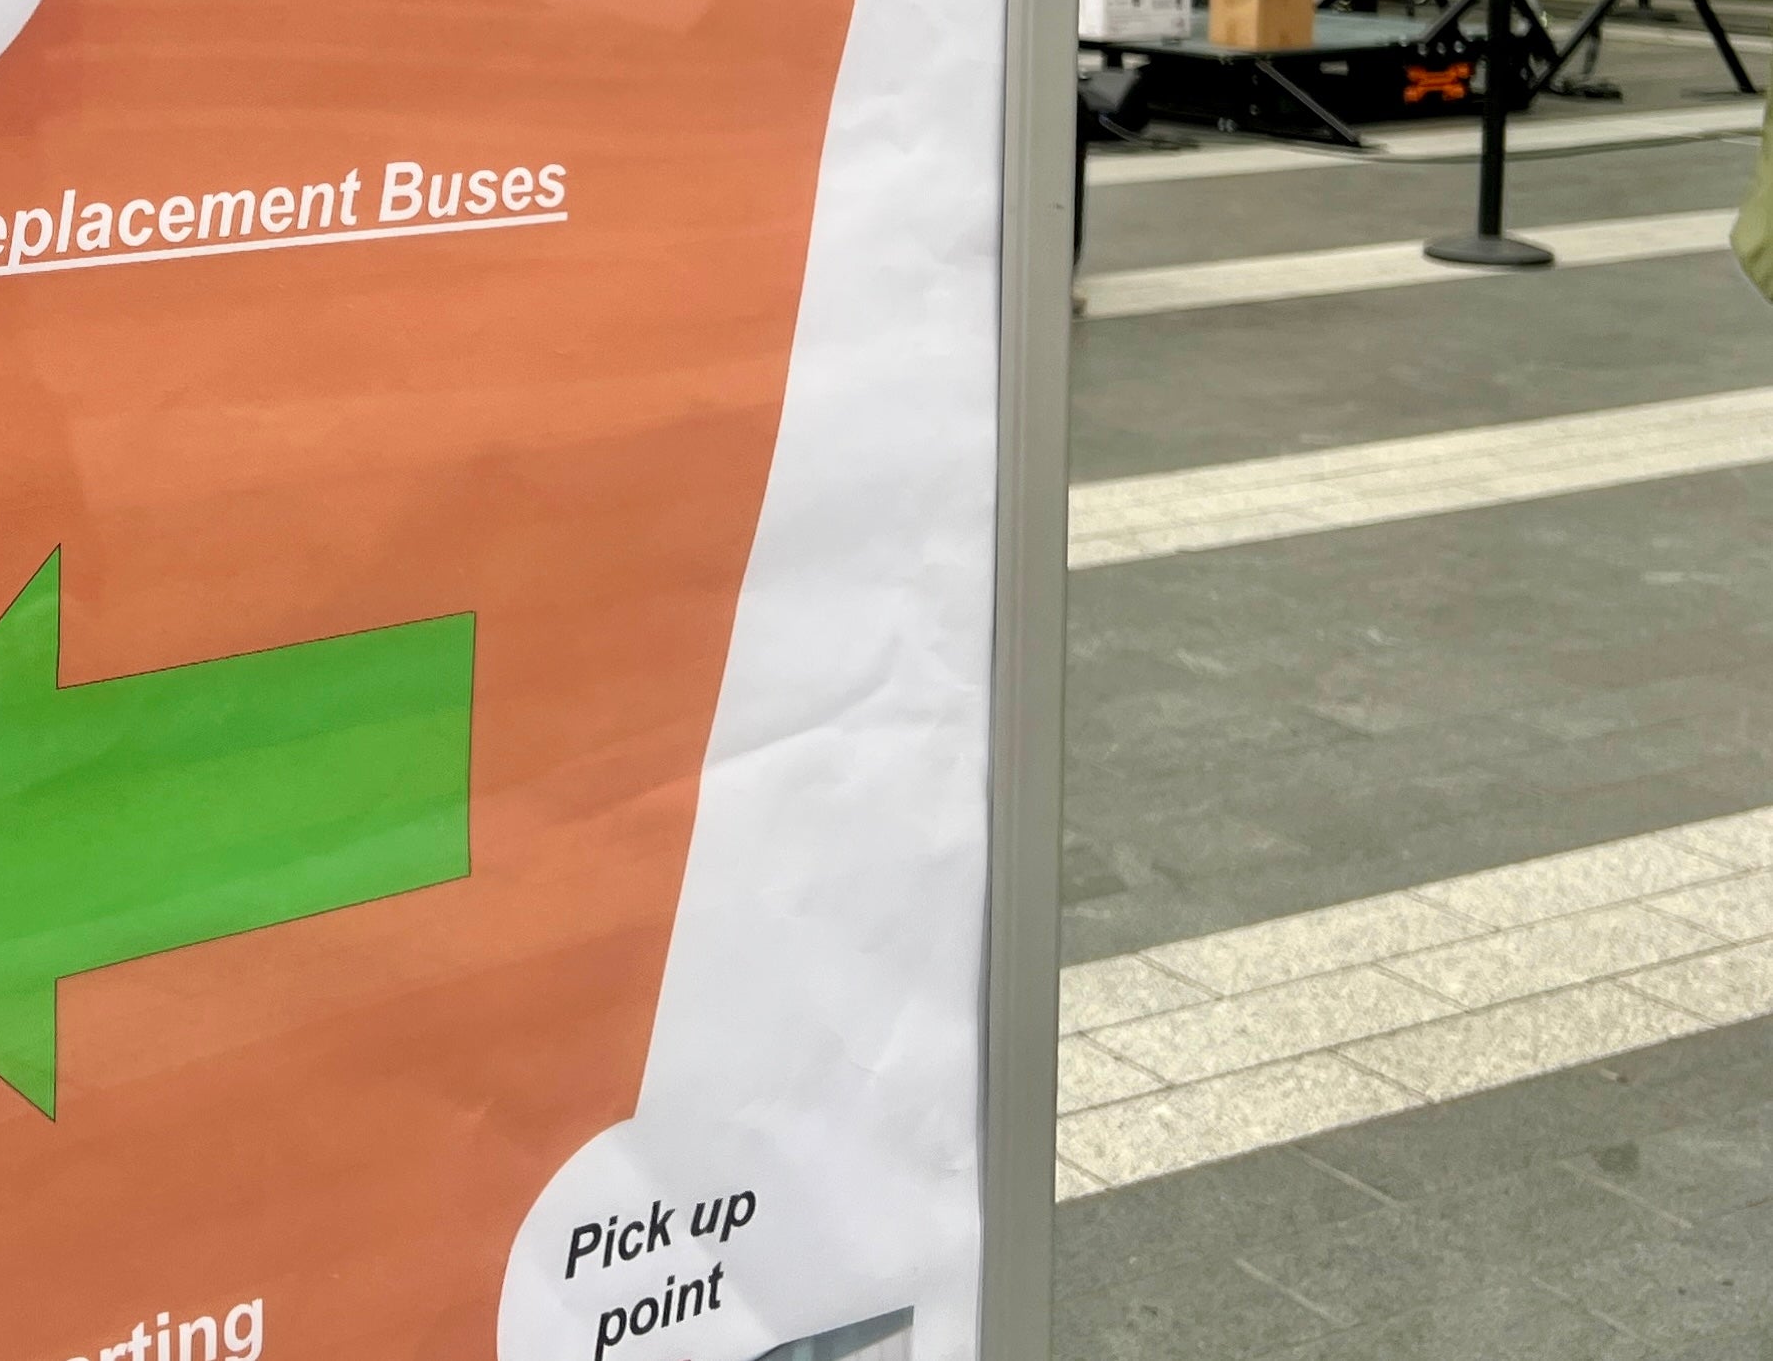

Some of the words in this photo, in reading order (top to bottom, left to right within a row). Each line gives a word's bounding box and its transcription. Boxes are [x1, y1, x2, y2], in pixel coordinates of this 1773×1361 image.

[378, 161, 569, 224] Buses
[564, 1199, 677, 1280] Pick
[689, 1190, 757, 1243] up
[593, 1261, 725, 1361] point
